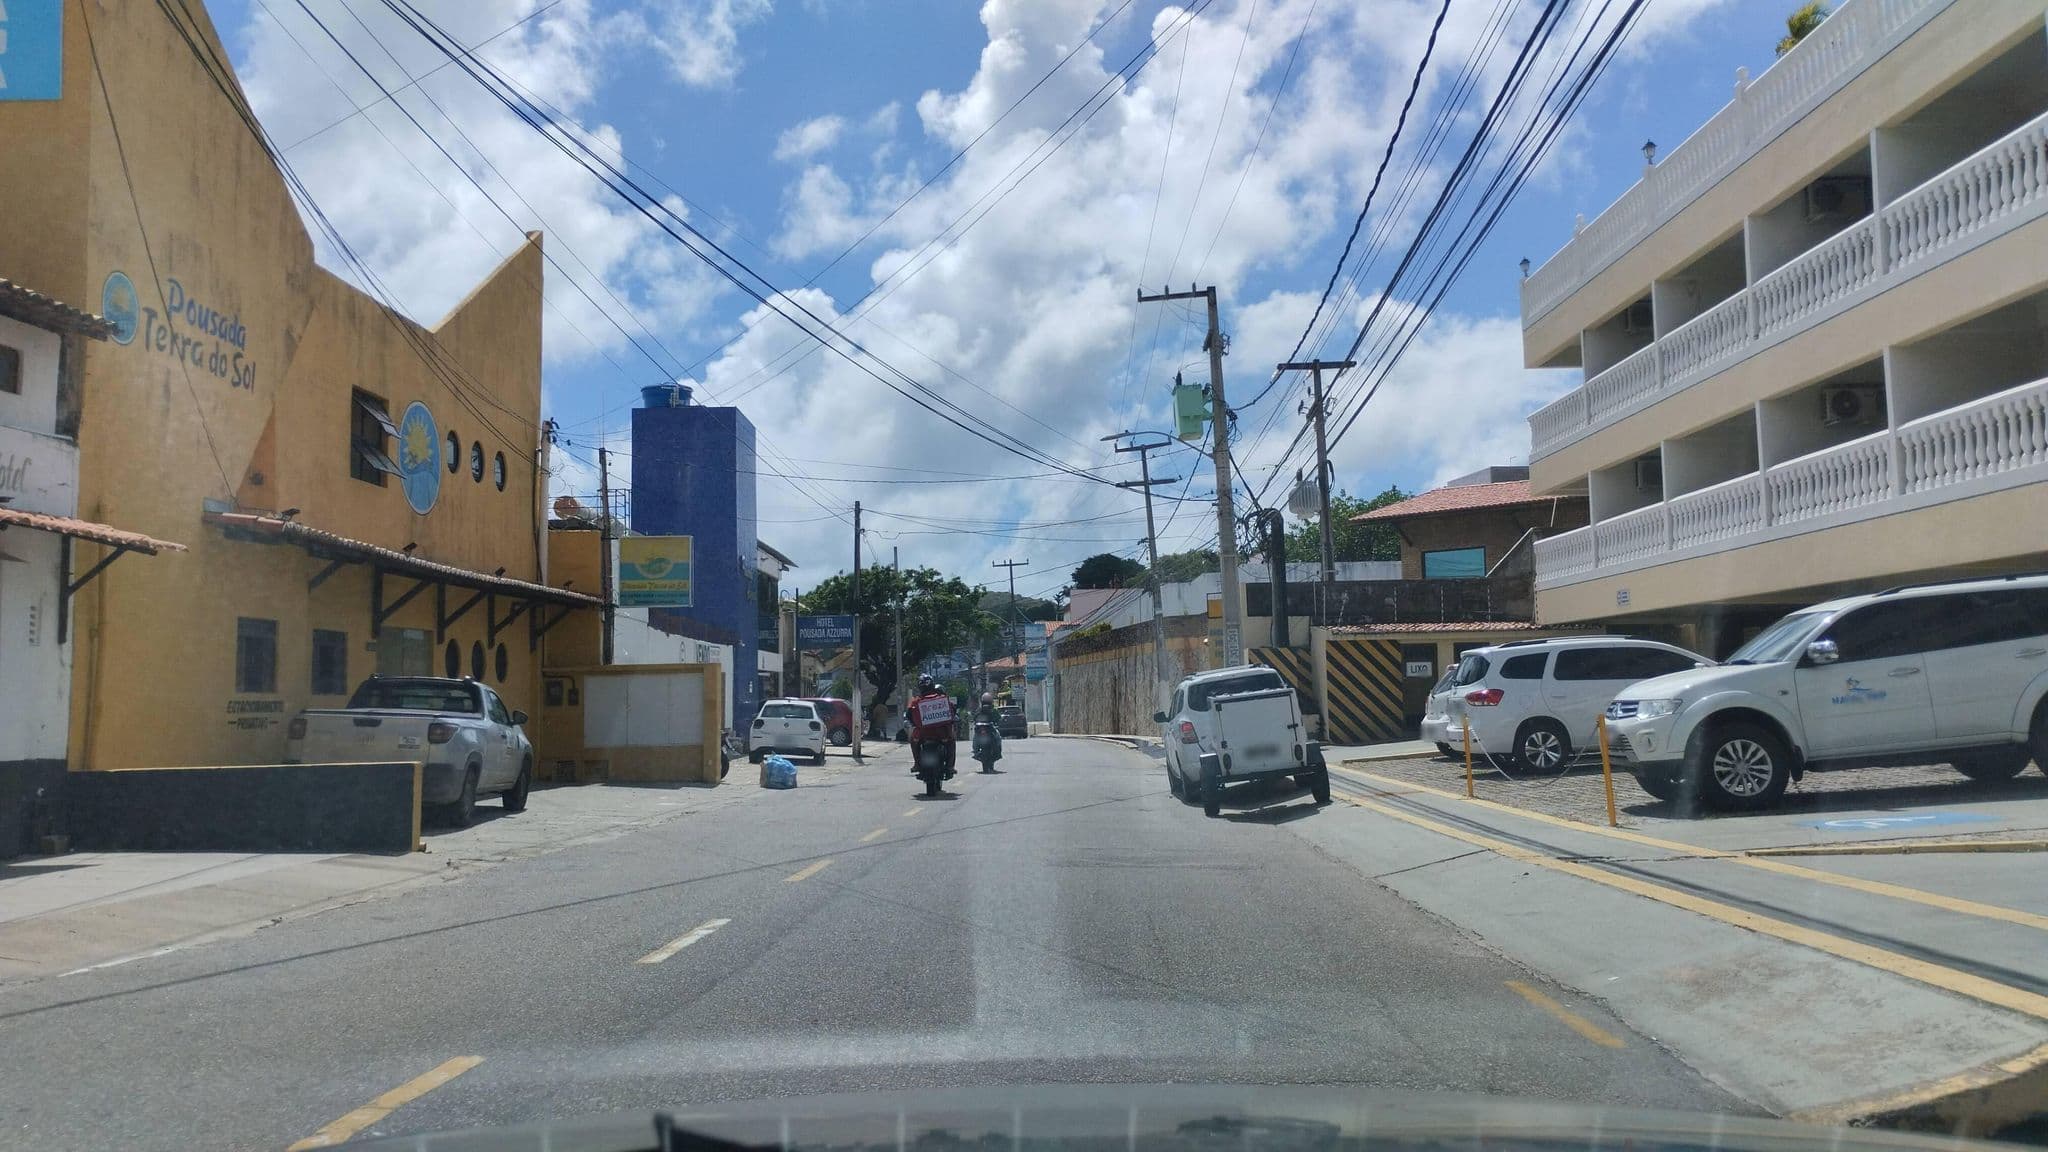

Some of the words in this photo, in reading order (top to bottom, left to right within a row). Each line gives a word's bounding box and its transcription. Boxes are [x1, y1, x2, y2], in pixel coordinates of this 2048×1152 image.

[167, 278, 246, 352] Pousada
[142, 307, 203, 368] Terra
[208, 341, 228, 377] do
[231, 352, 256, 394] Sol
[800, 629, 825, 639] POUSADA
[827, 628, 852, 638] AZZURRA
[816, 617, 834, 627] HOTEL
